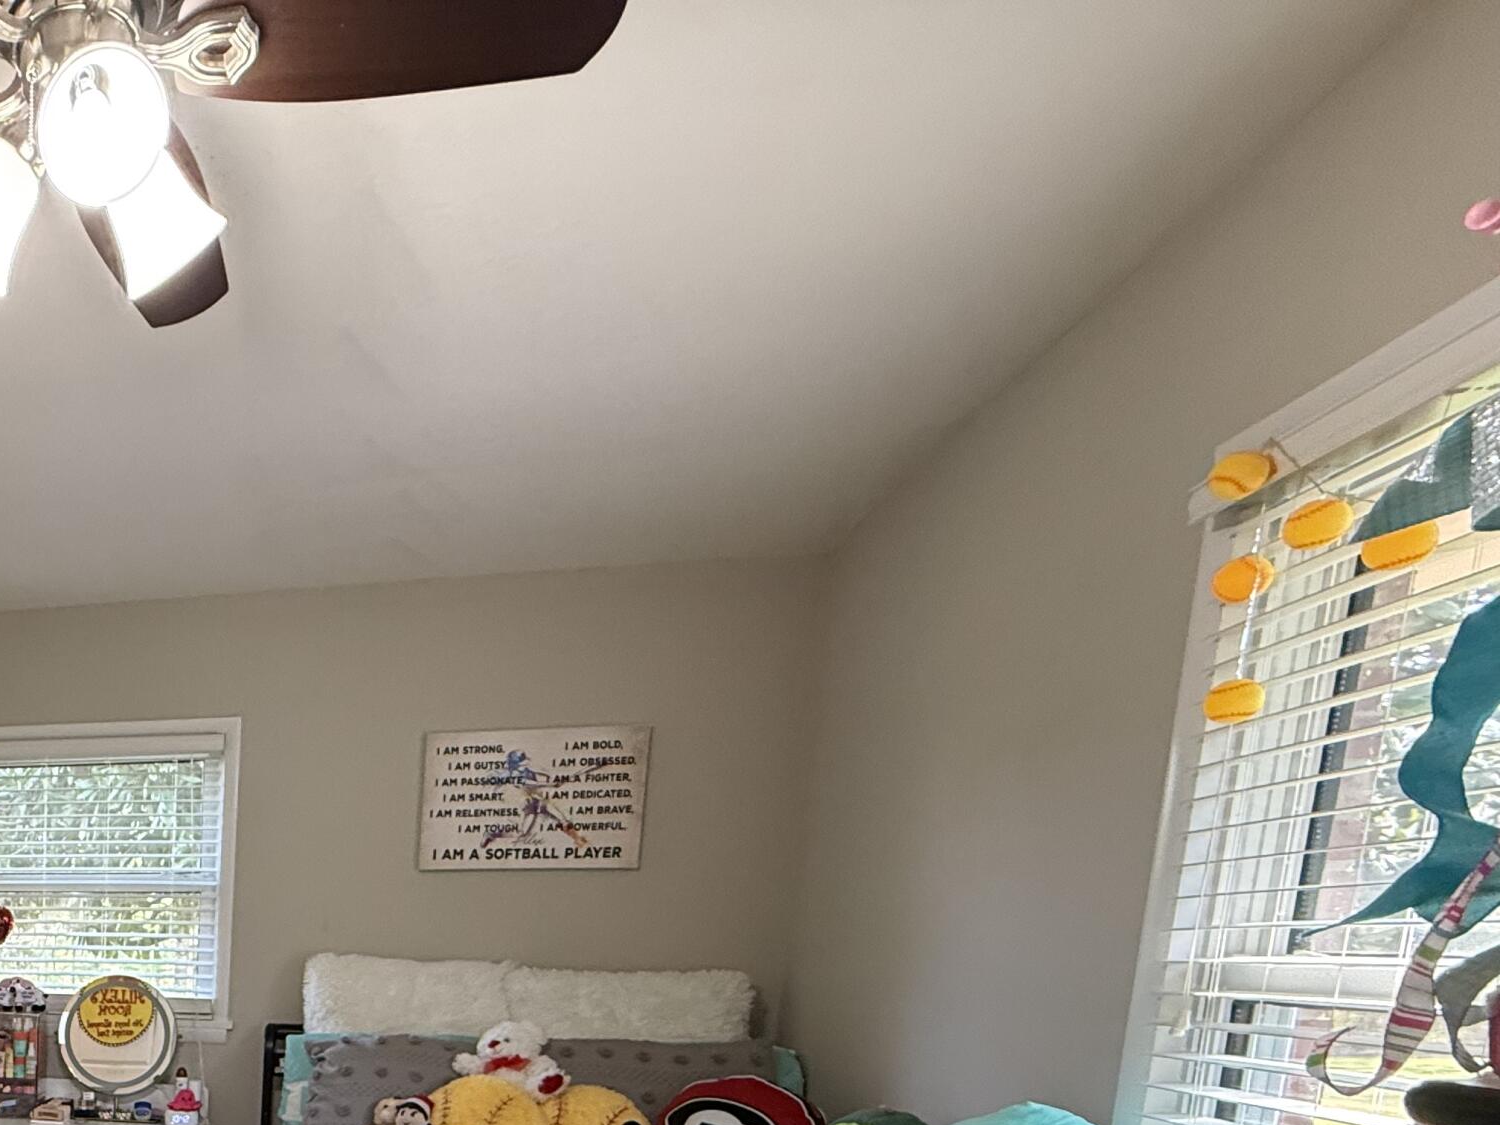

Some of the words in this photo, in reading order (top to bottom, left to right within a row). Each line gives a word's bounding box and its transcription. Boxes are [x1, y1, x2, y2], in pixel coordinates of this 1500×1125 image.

[565, 742, 568, 750] I
[572, 741, 588, 750] AM
[437, 747, 440, 755] I
[443, 746, 459, 755] AM
[448, 762, 451, 771] I
[454, 762, 470, 770] AM
[552, 759, 555, 767] I
[559, 758, 575, 767] AM
[441, 778, 457, 786] AM
[546, 775, 550, 783] I
[553, 775, 569, 783] AM
[574, 774, 581, 782] A
[443, 794, 446, 802] I
[449, 794, 465, 802] AM
[545, 791, 549, 800] I
[552, 791, 569, 799] AM
[430, 810, 433, 818] I
[436, 809, 452, 818] AM
[569, 807, 573, 815] I
[576, 806, 593, 815] AM
[458, 825, 461, 833] I
[465, 825, 480, 833] AM
[540, 823, 543, 832] I
[547, 823, 563, 831] AM
[433, 849, 436, 860] I
[442, 849, 464, 860] AM
[469, 849, 479, 860] A
[485, 848, 559, 860] SOFTBALL
[564, 846, 622, 859] PLAYER
